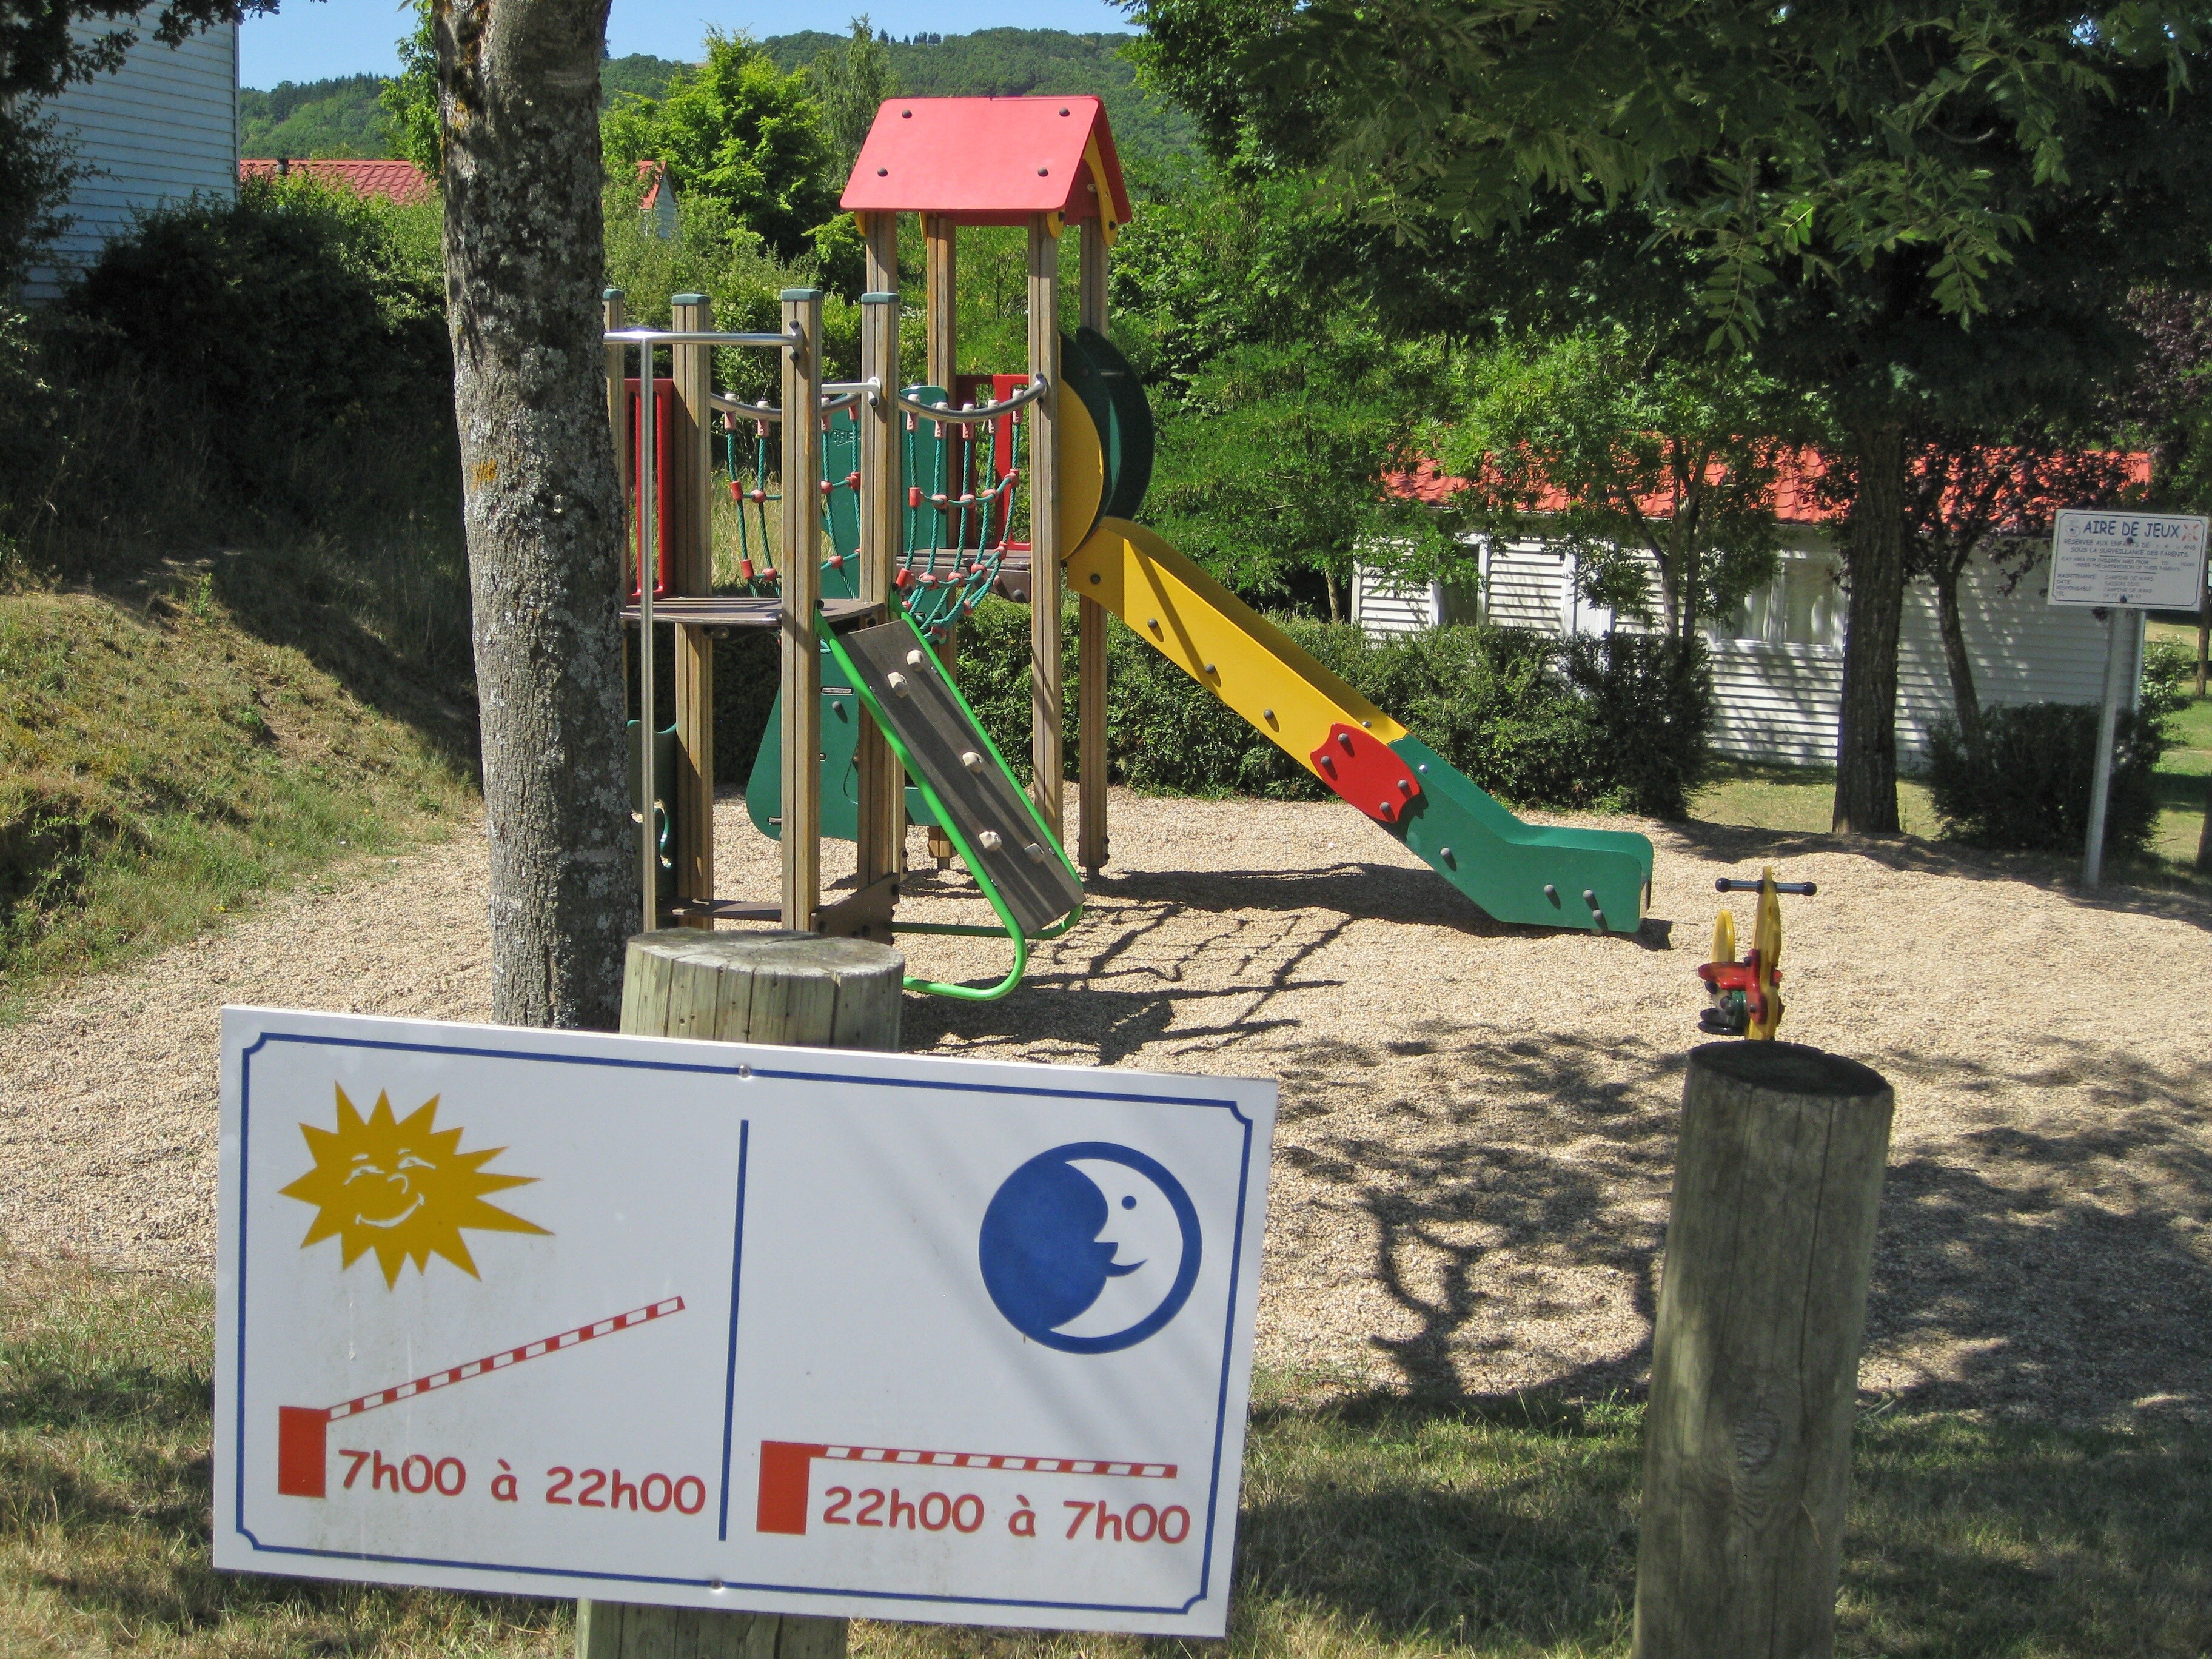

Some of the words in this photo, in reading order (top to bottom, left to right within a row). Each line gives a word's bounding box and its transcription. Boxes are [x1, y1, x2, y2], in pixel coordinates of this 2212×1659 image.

[2083, 521, 2116, 535] AIRE
[2122, 521, 2139, 536] DE
[2145, 523, 2180, 538] JEUX
[340, 1450, 466, 1496] 7h00
[491, 1459, 518, 1503] à
[546, 1467, 706, 1515] 22h00
[824, 1487, 984, 1533] 22h00
[1009, 1495, 1035, 1538] à
[1065, 1501, 1190, 1544] 7h00
